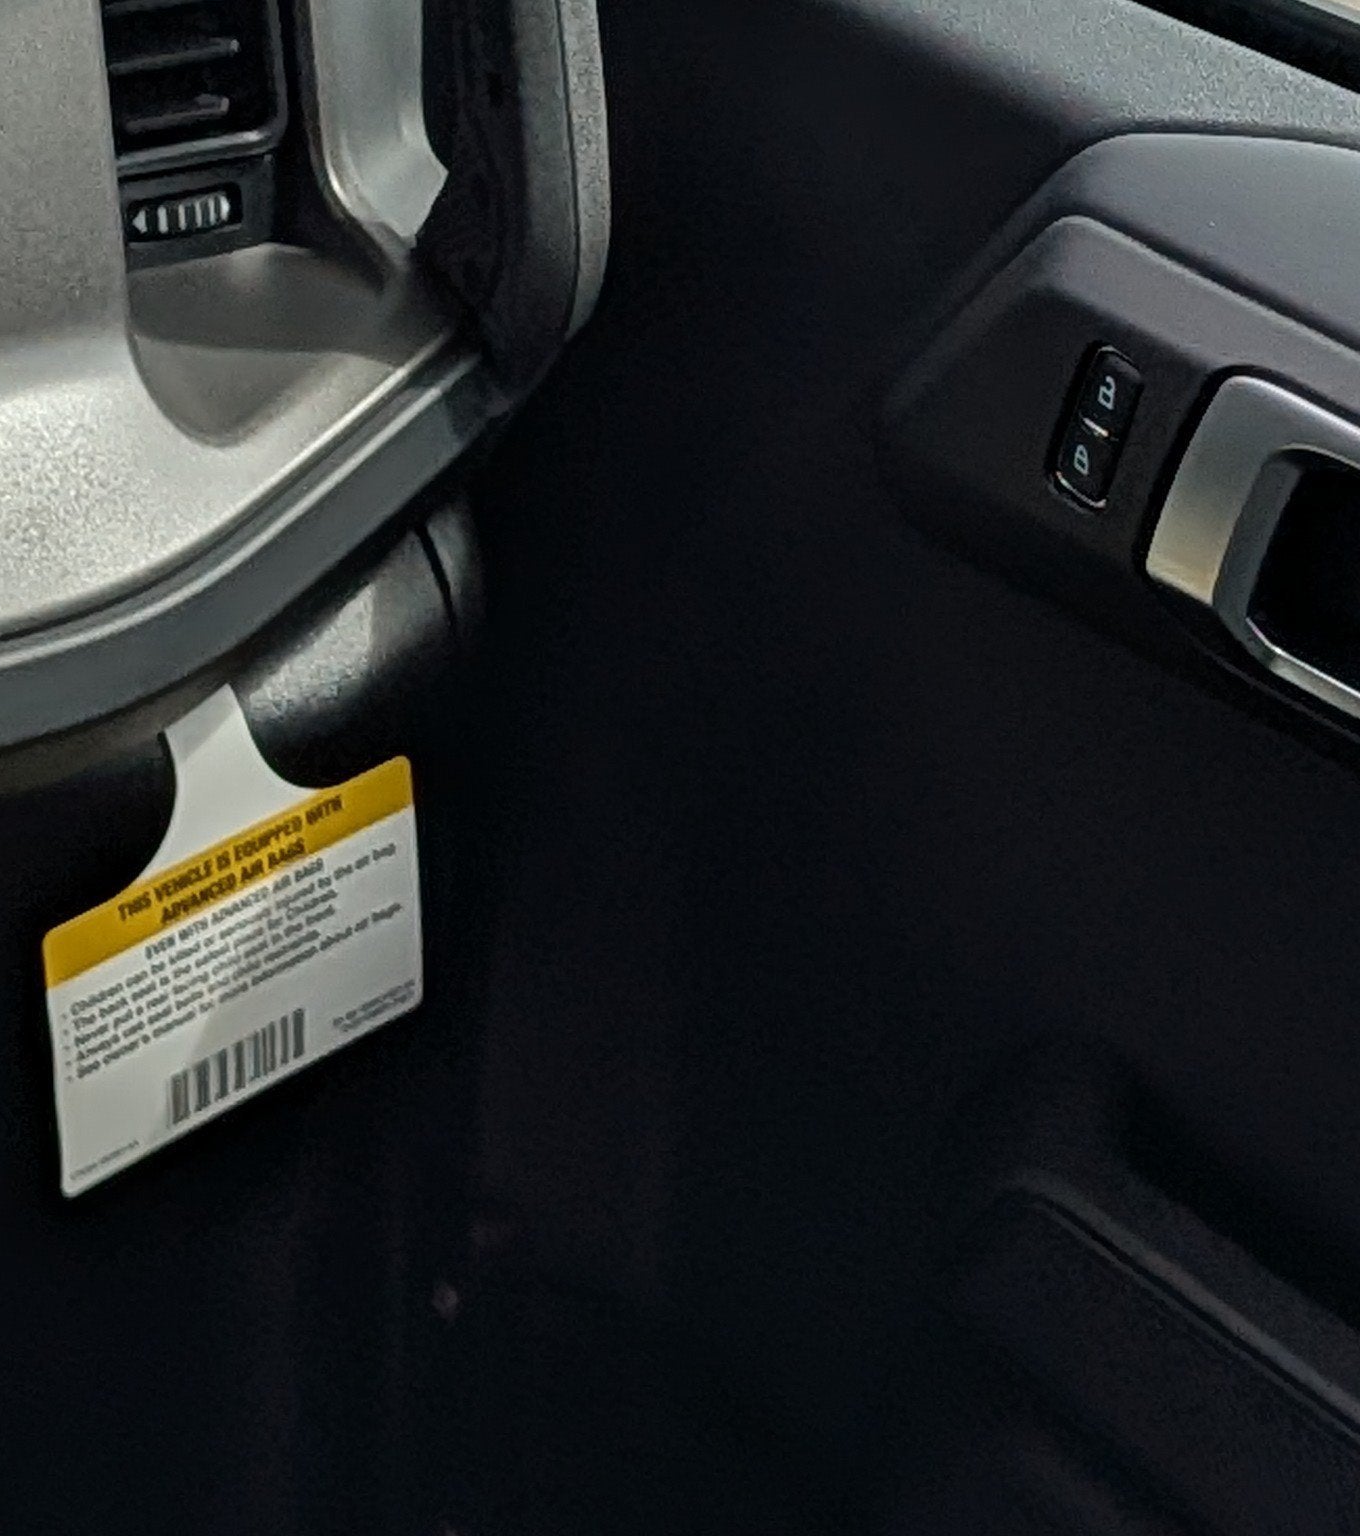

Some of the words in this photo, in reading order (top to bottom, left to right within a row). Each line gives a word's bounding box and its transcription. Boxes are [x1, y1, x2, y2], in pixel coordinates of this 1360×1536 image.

[116, 890, 153, 923] THIS
[152, 858, 214, 904] VEHICLE
[215, 849, 232, 873] IS
[232, 815, 304, 863] EQUIPPED
[304, 793, 344, 827] WITH
[159, 872, 238, 927] ADVANCED
[239, 858, 265, 885] AIR
[266, 836, 307, 871] BAGS
